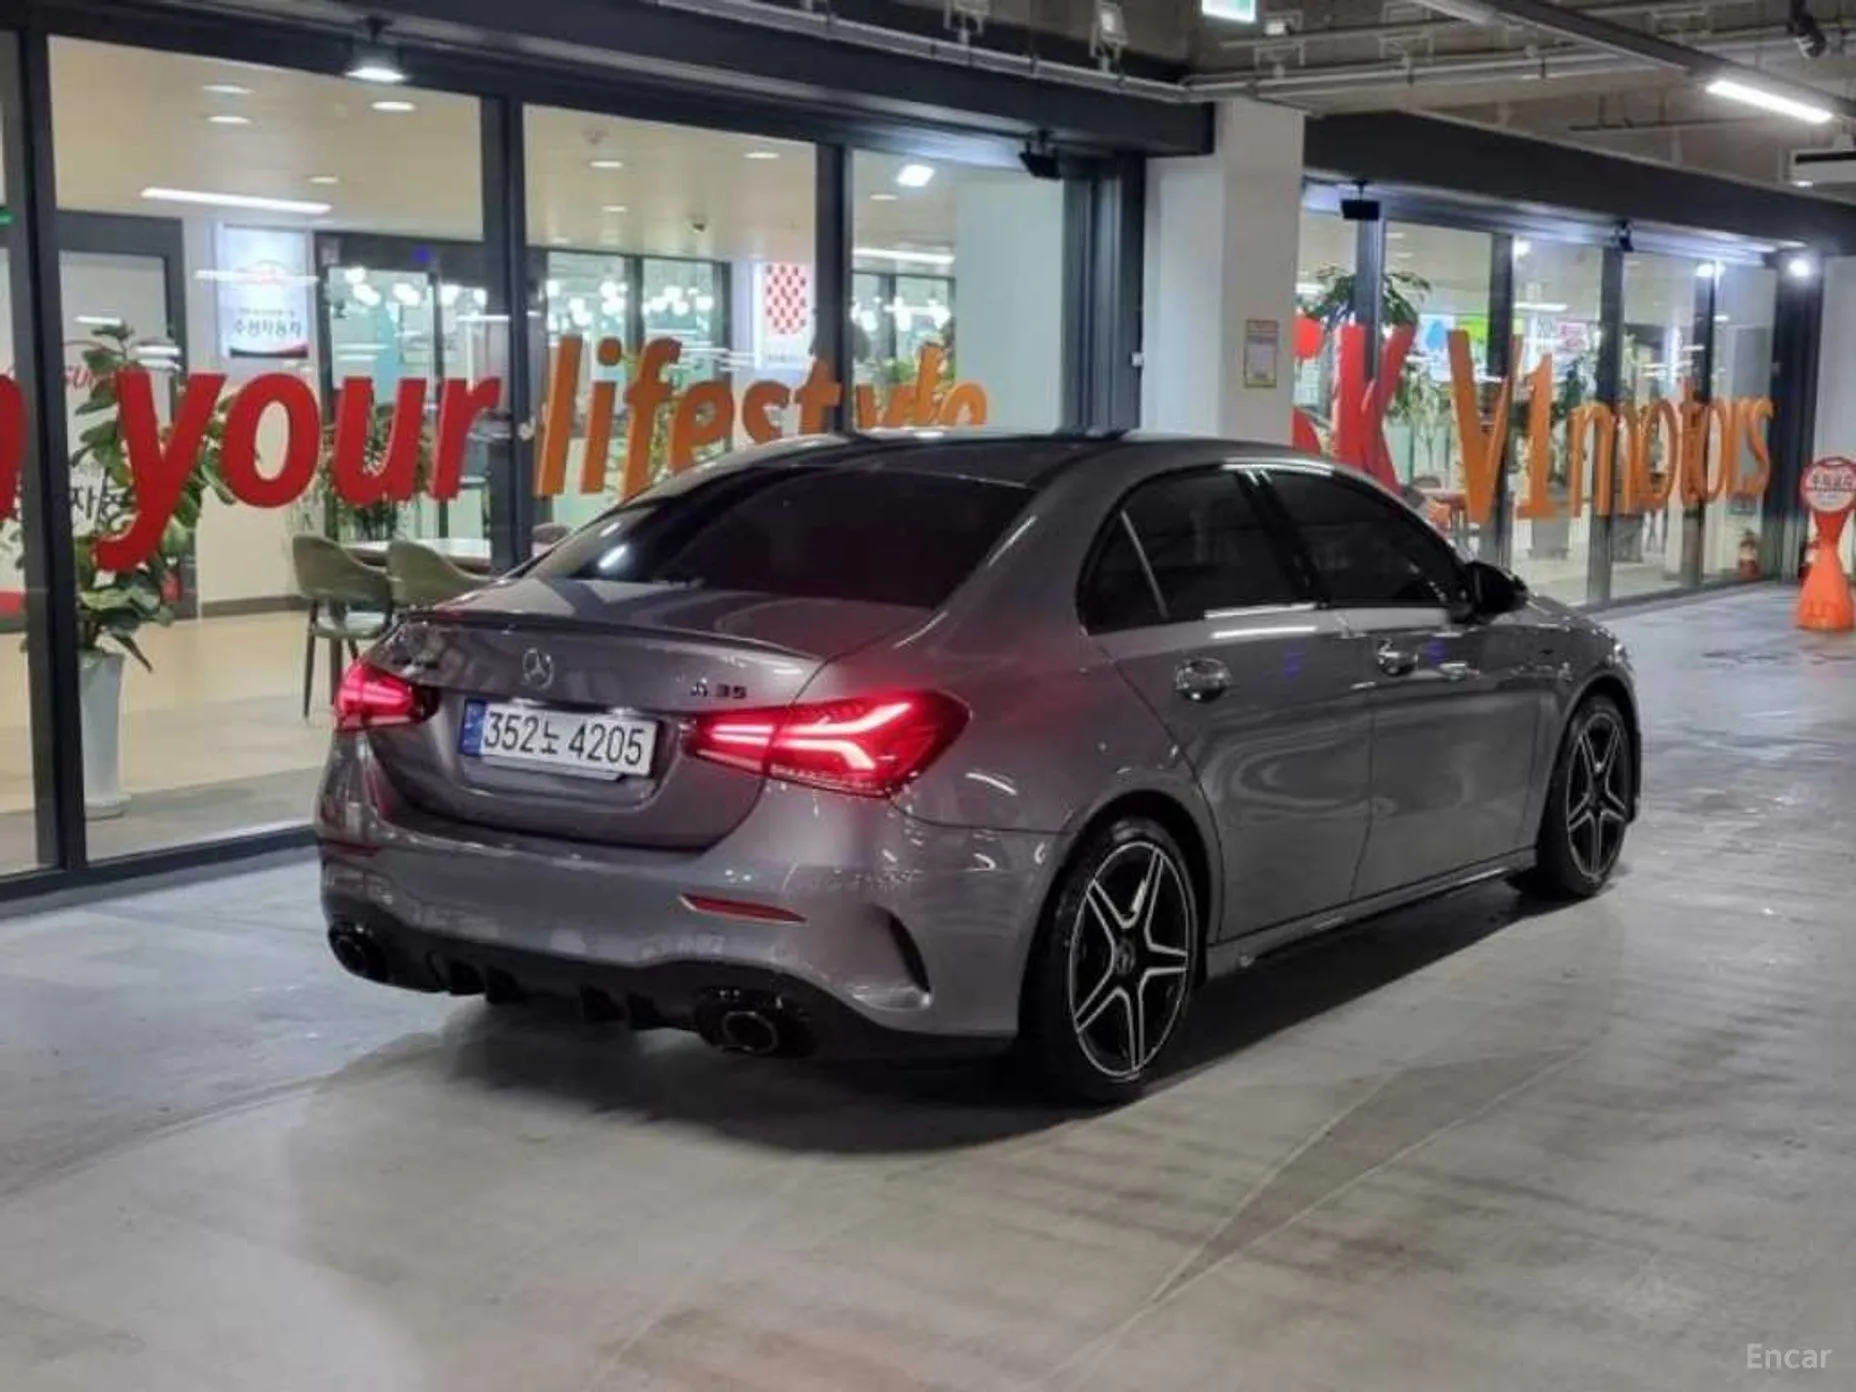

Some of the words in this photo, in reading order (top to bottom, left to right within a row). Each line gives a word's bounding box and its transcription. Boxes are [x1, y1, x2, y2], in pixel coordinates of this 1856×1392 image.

[91, 372, 501, 573] your
[1292, 311, 1415, 498] K
[1448, 329, 1557, 525] V1
[484, 710, 560, 755] 352노
[568, 721, 645, 766] 4205
